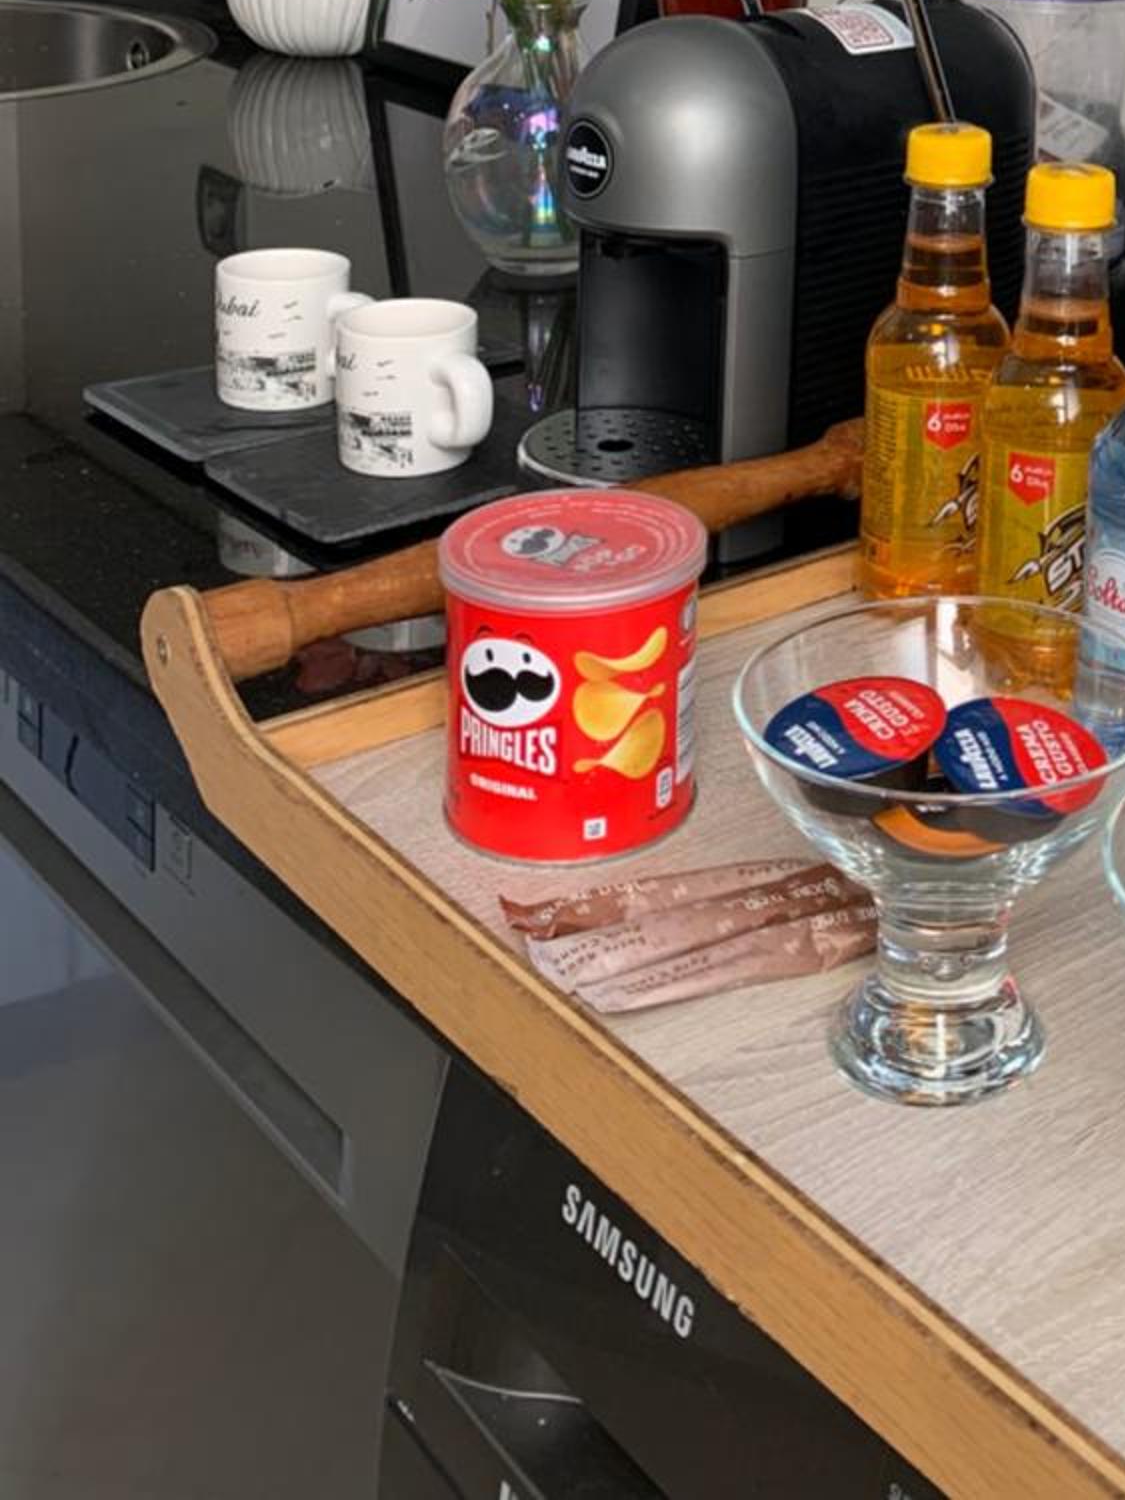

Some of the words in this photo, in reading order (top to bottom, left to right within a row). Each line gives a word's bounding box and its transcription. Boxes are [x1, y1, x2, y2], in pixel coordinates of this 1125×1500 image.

[927, 411, 942, 432] 6
[1010, 463, 1024, 484] 6
[460, 706, 557, 777] PRINGLES
[562, 1184, 695, 1338] SAMSUNG
